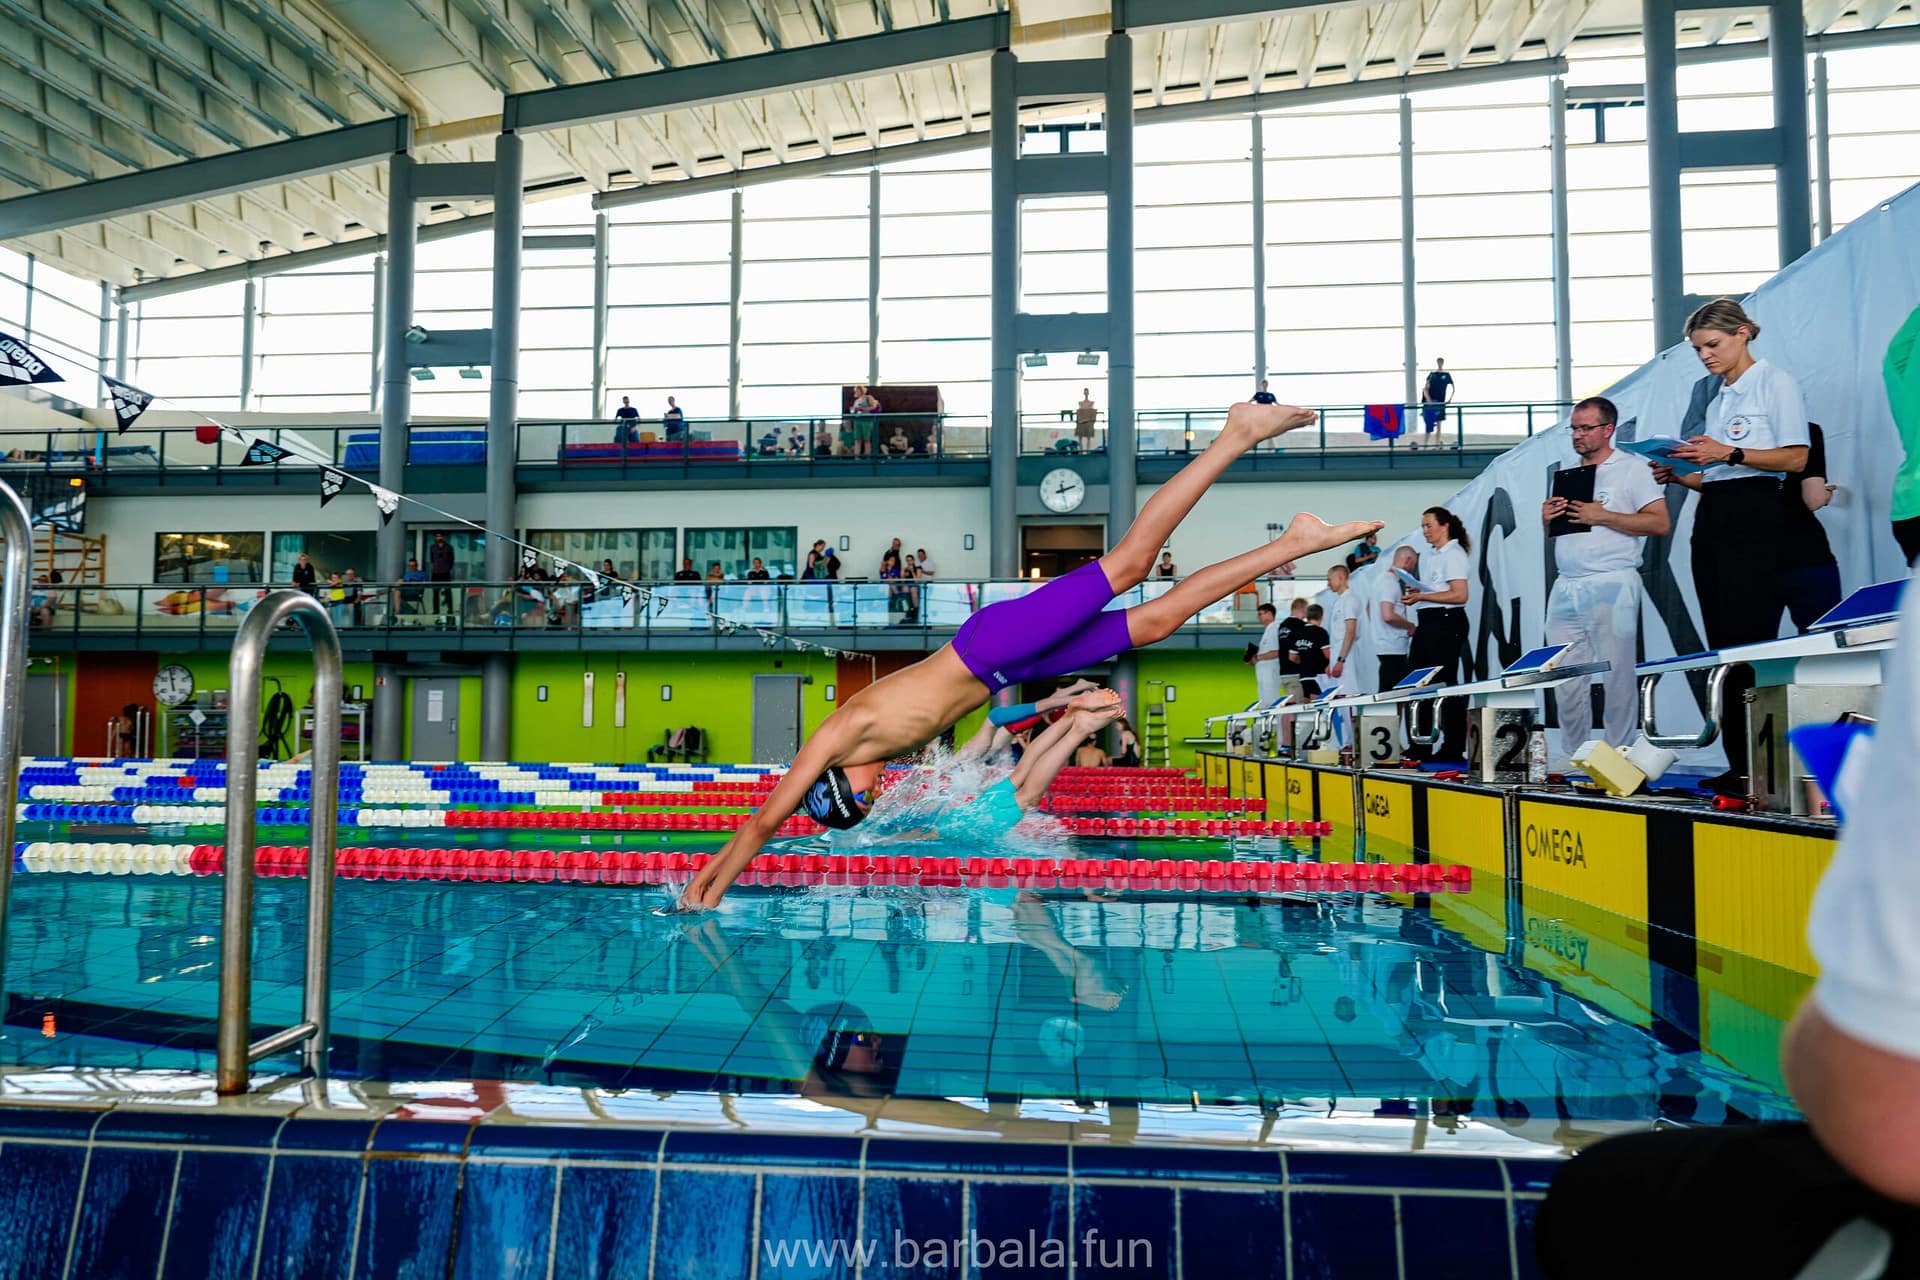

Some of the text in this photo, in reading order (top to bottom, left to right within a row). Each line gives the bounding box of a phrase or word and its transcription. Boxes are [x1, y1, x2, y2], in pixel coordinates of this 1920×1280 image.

[0, 339, 46, 376] arena
[1370, 726, 1393, 760] 3
[1495, 723, 1529, 772] 2
[1758, 713, 1776, 795] 1
[1525, 823, 1587, 869] OMEGA
